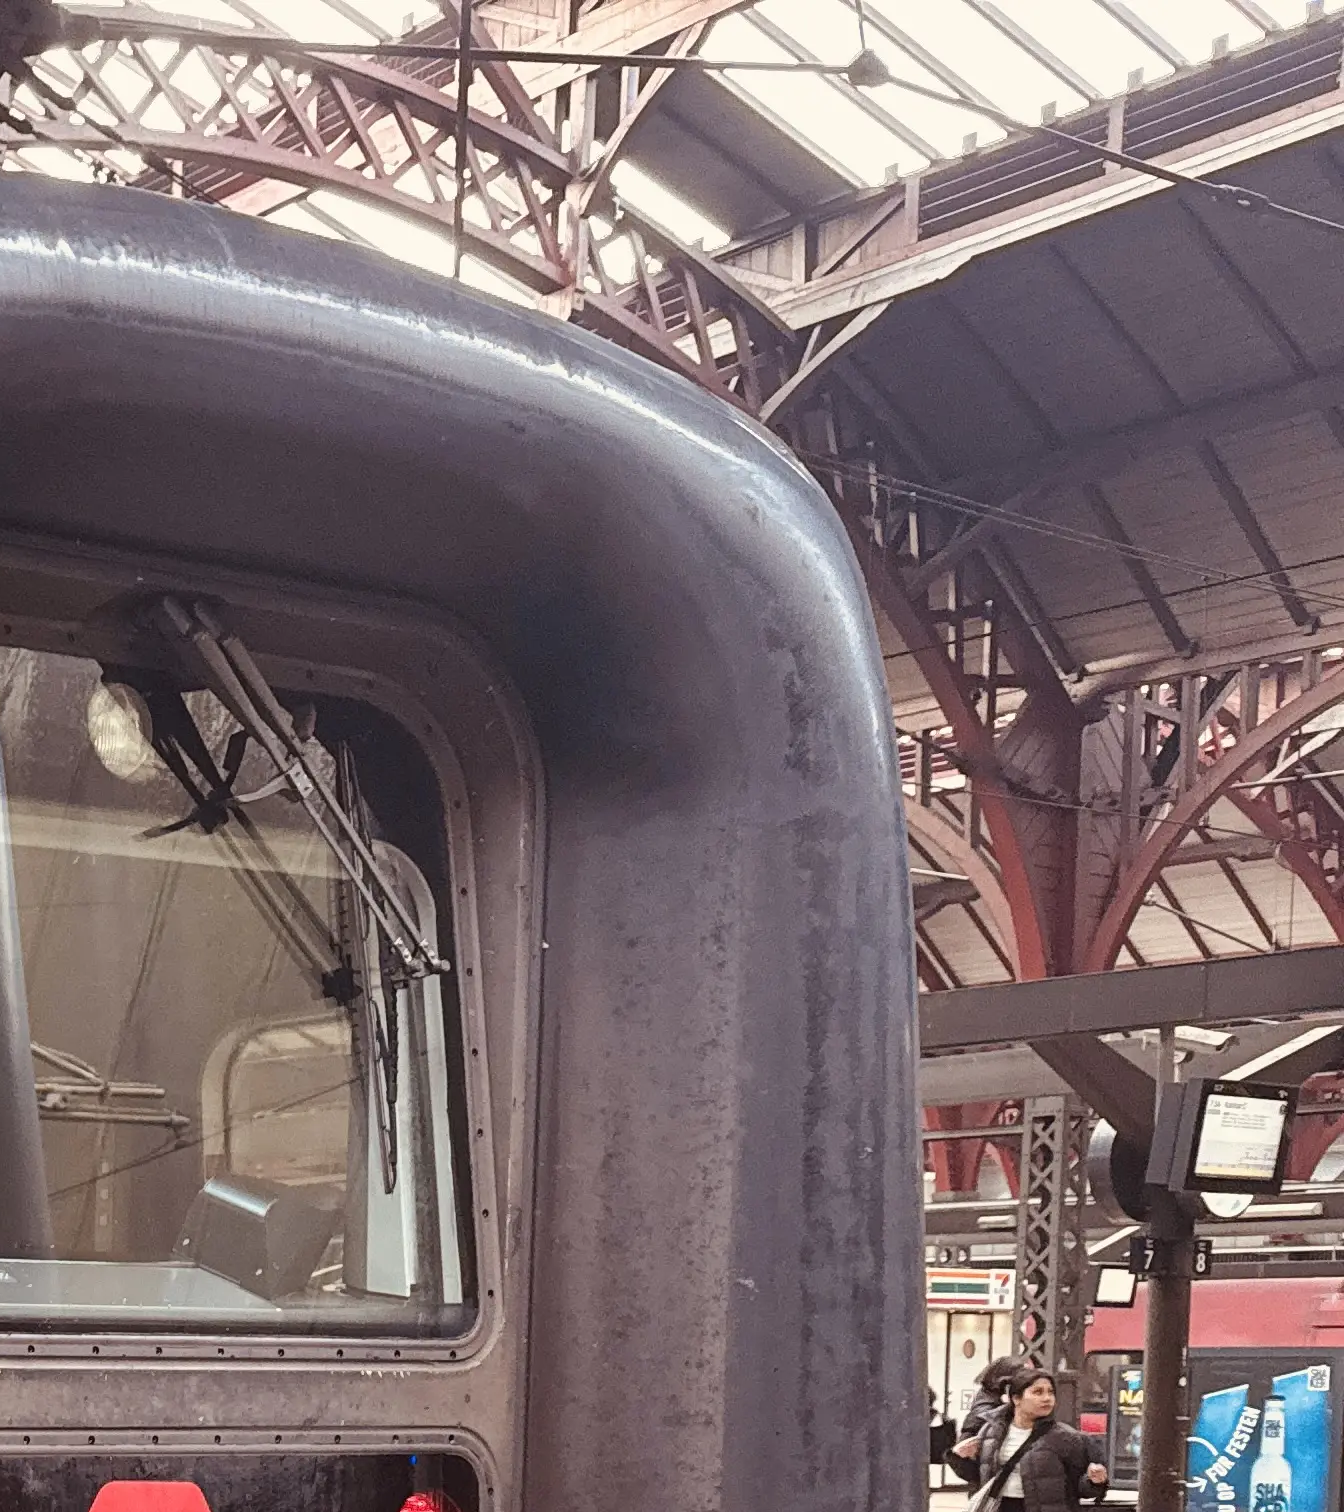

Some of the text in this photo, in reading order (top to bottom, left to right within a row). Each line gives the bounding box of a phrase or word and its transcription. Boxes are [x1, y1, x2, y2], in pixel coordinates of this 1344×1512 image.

[1144, 1250, 1154, 1270] 7
[1196, 1252, 1206, 1273] 8
[1224, 1405, 1262, 1459] FESTEN
[1204, 1455, 1236, 1484] FOR
[1216, 1482, 1236, 1501] OP
[1255, 1483, 1285, 1500] SHA
